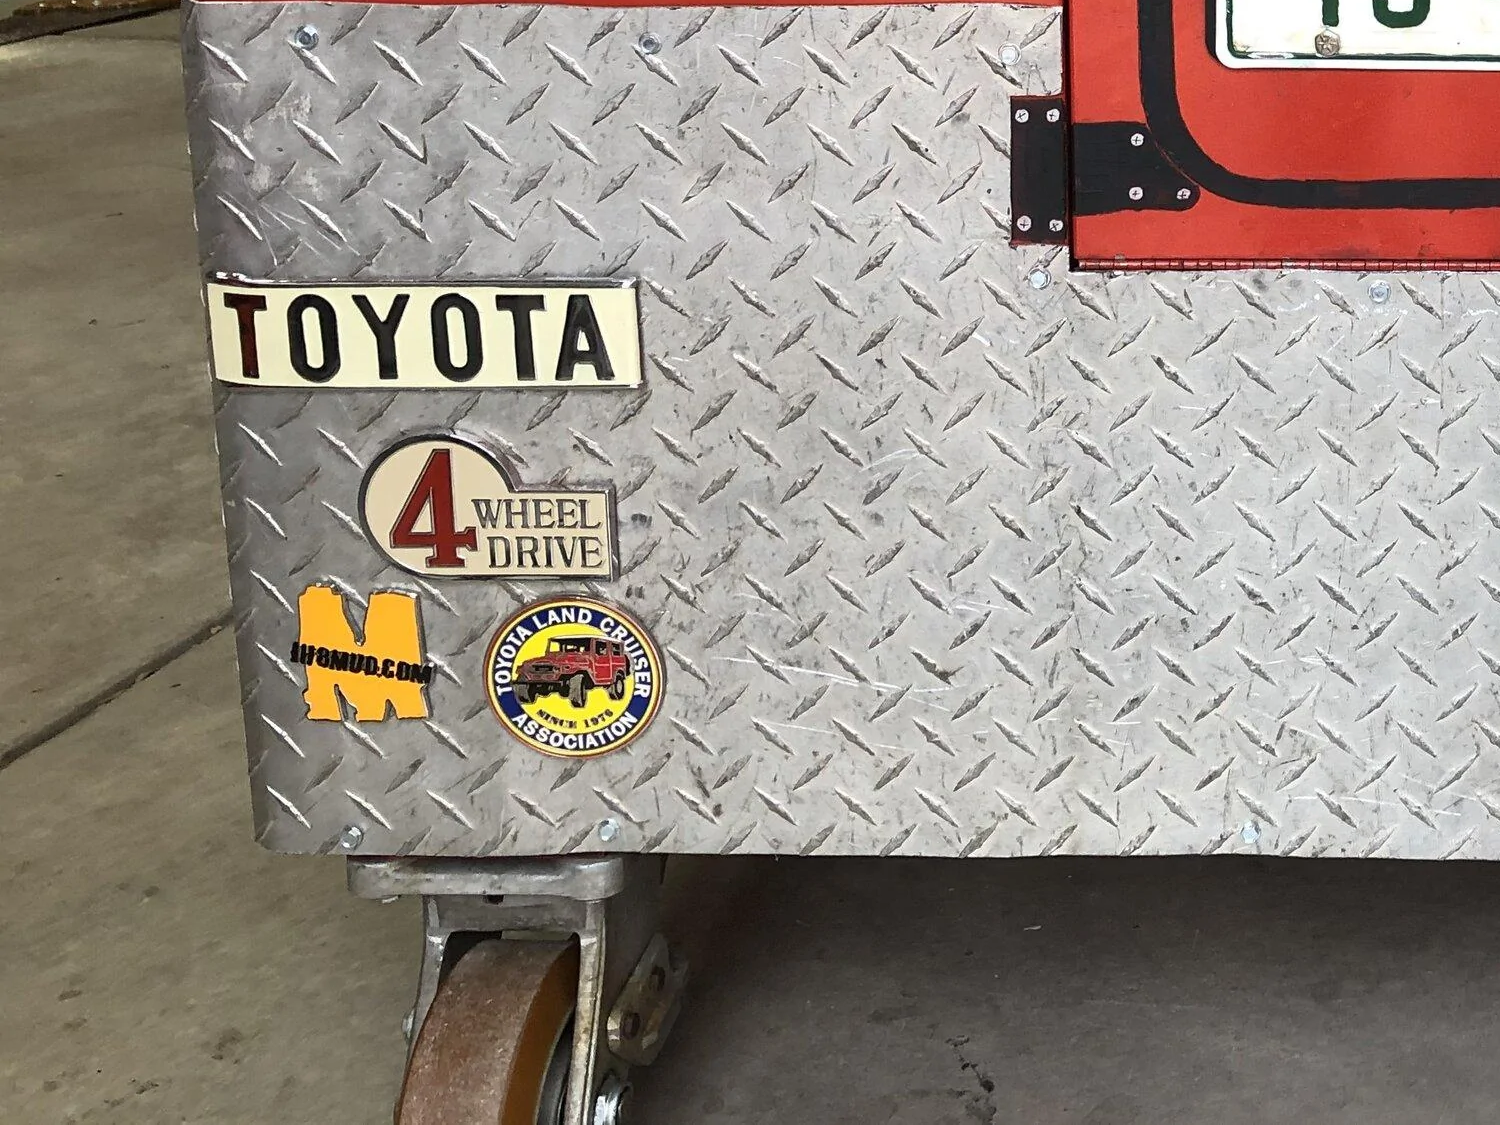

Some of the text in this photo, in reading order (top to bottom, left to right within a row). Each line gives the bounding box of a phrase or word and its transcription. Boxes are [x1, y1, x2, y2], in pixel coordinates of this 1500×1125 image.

[224, 294, 616, 380] TOYOTA
[390, 448, 478, 568] 4
[472, 499, 602, 530] WHEEL
[488, 537, 606, 569] DRIVE
[290, 641, 433, 684] IH8MUD.COM
[495, 607, 650, 698] TOYOTA LAND CRUISER
[512, 711, 638, 749] ASSOCIATION
[536, 709, 578, 729] SINCE
